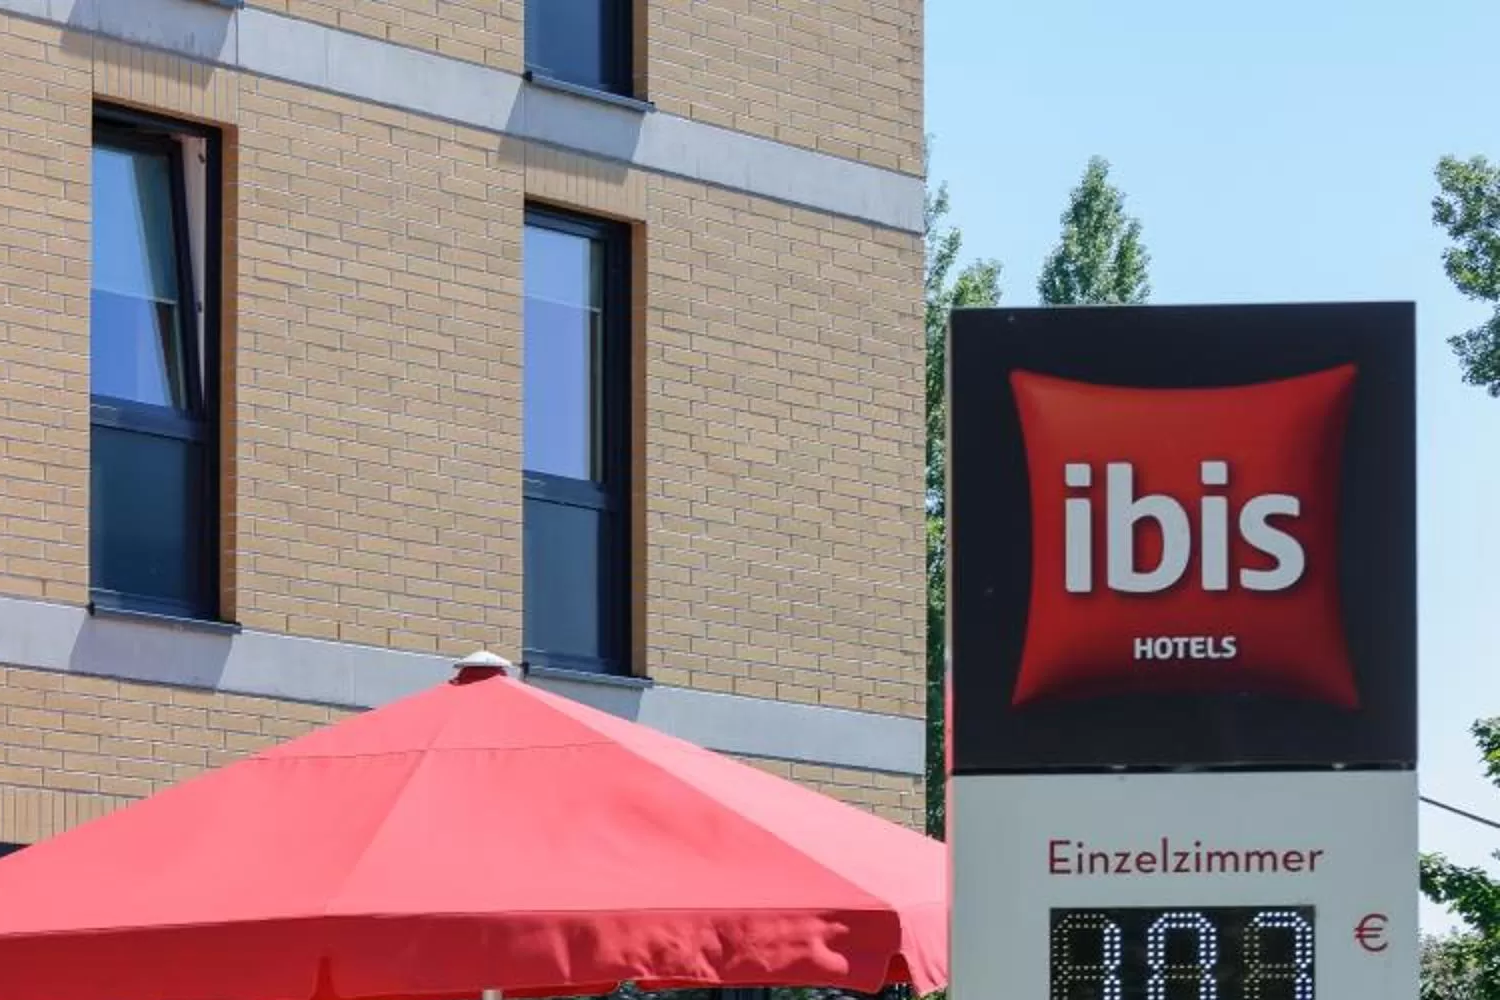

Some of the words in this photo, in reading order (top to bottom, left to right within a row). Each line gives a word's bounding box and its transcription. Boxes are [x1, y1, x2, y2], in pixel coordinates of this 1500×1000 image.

[1064, 460, 1305, 593] ibis
[1133, 636, 1237, 660] HOTELS
[1048, 837, 1324, 875] Einzelzimmer
[1354, 913, 1389, 952] €
